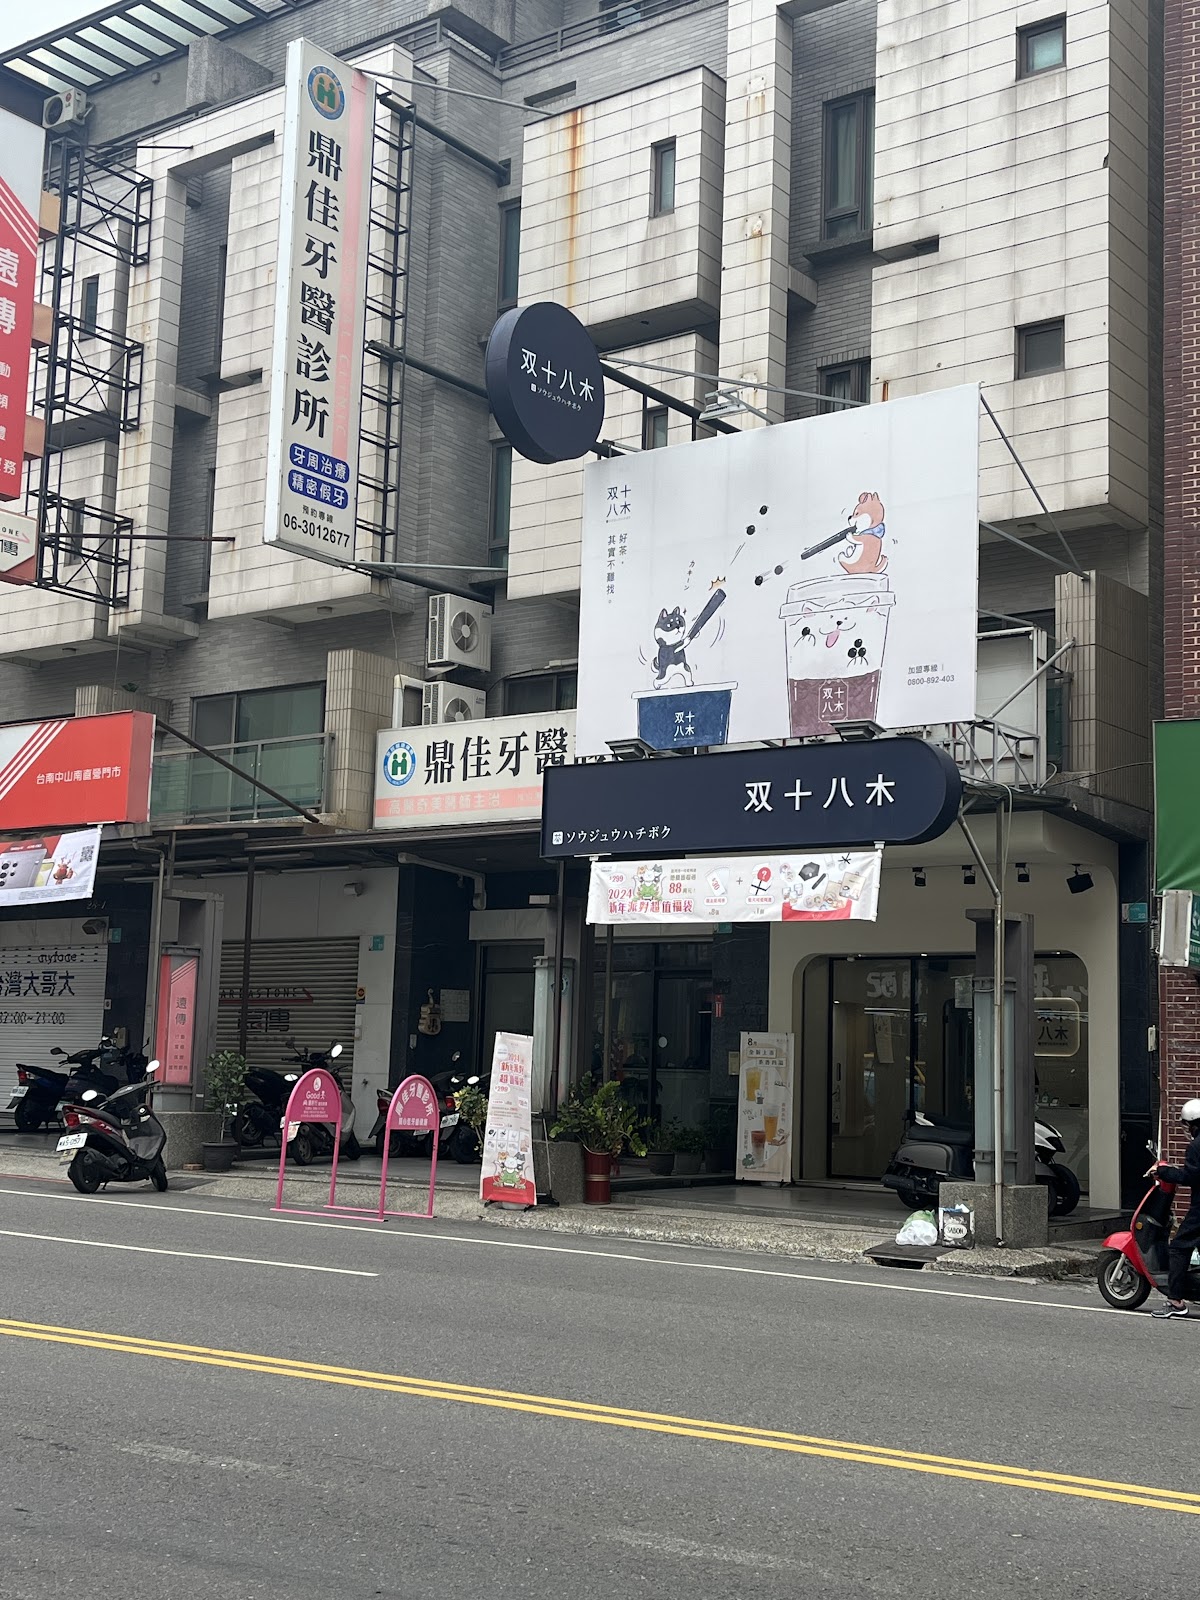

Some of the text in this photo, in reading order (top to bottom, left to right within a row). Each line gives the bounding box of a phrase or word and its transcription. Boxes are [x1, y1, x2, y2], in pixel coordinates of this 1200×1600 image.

[291, 130, 343, 438] 鼎佳牙醫診所
[520, 347, 595, 402] 双十八木
[293, 446, 346, 480] 牙周治療
[292, 472, 345, 506] 精密假牙
[606, 484, 632, 500] 双十
[302, 504, 334, 524] 預約專線
[606, 501, 631, 518] 八木
[283, 513, 350, 548] 06-3012677
[907, 675, 955, 686] 0800-892-403
[822, 687, 845, 700] 双十
[822, 700, 845, 713] 八木
[674, 711, 695, 723] 双十
[674, 724, 695, 737] 八木
[423, 727, 607, 785] 鼎佳牙醫
[36, 765, 122, 785] 台南中山南直營門市
[743, 773, 896, 813] 双十八木
[566, 825, 672, 843] ソウジュウハチボク
[608, 888, 633, 900] 2024
[609, 899, 693, 915] 新年派對超值福袋
[0, 970, 75, 997] 灣大哥大
[175, 997, 187, 1026] 遠傳
[1038, 1026, 1068, 1041] 八木
[306, 1090, 321, 1100] Good
